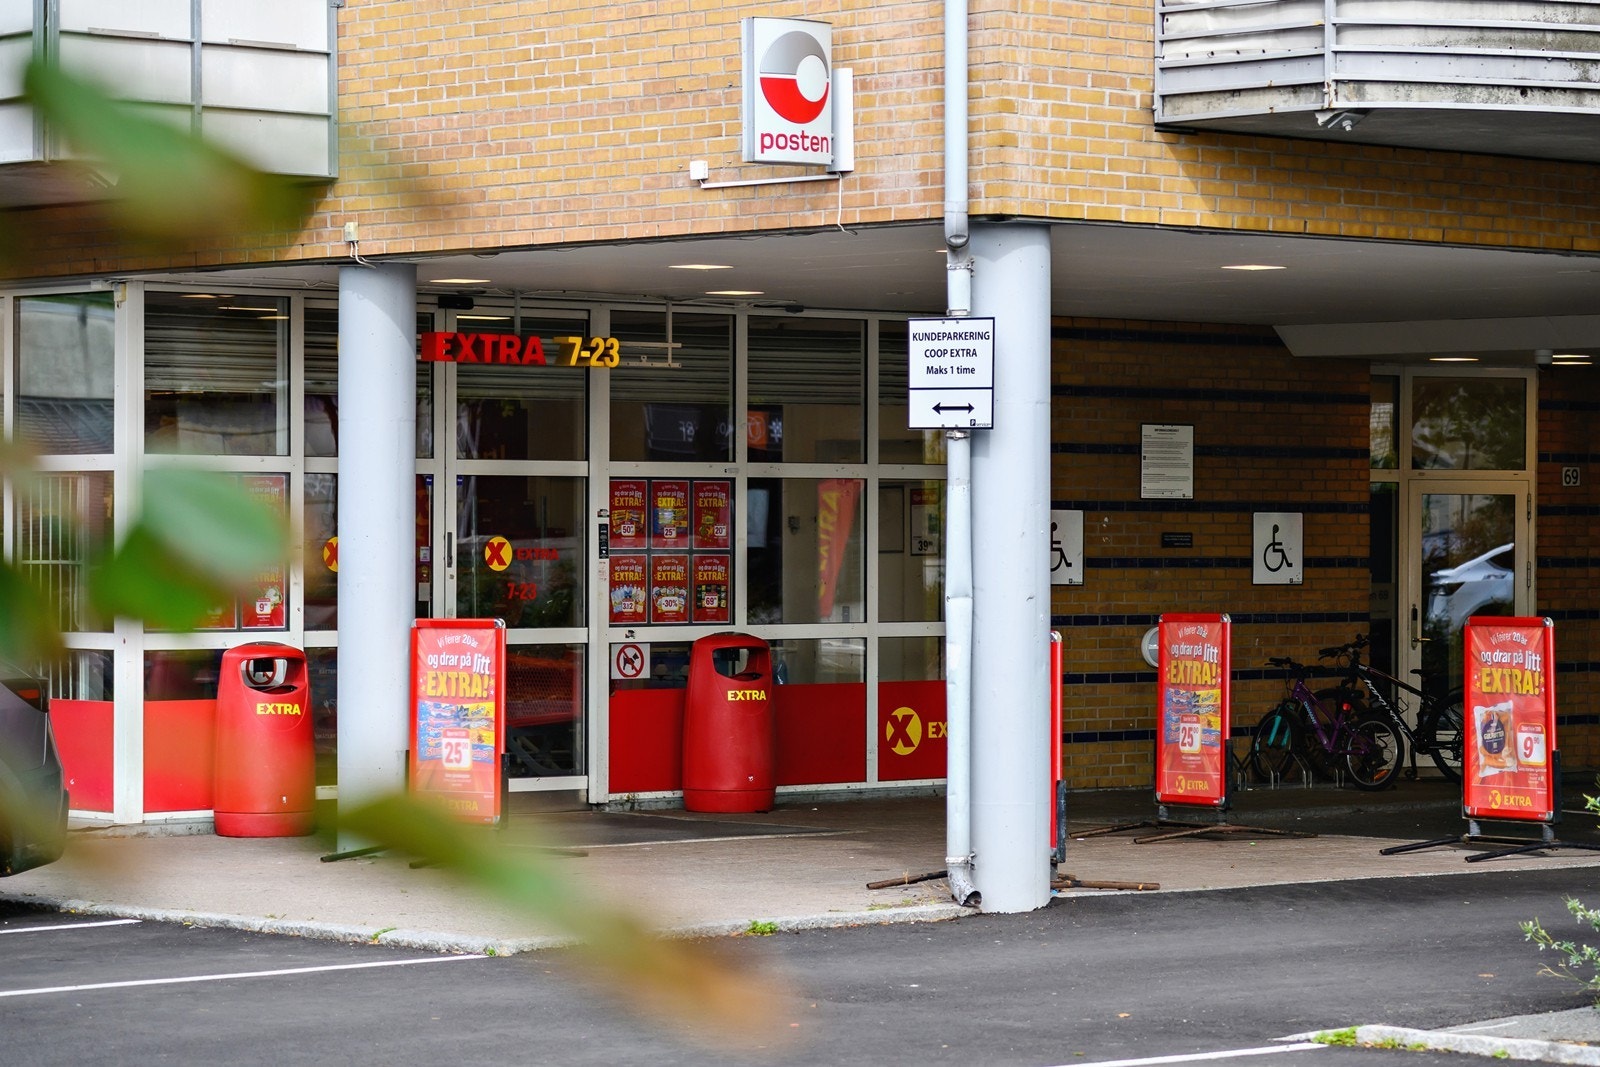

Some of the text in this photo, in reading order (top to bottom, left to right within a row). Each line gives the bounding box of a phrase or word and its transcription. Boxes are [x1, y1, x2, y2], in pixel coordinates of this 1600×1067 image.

[760, 130, 829, 154] posten
[912, 332, 990, 341] KUNDEPARKERING
[435, 332, 620, 368] EXTRA 7-23
[924, 348, 978, 358] COOP EXTRA
[926, 366, 976, 374] Maks 1 time
[1564, 468, 1578, 484] 69
[615, 497, 642, 506] EXTRA!
[658, 498, 684, 506] EXTRA!
[699, 498, 725, 507] EXTRA!
[516, 548, 559, 561] EXTRA
[614, 572, 642, 580] EXTRA!
[657, 572, 684, 580] EXTRA!
[698, 572, 725, 580] EXTRA!
[507, 583, 537, 600] 7-23
[437, 636, 444, 648] Vi
[444, 634, 461, 644] feirer
[1497, 632, 1511, 641] feirer
[1171, 642, 1218, 663] og drar på litt
[428, 652, 490, 674] og drar på litt
[1481, 649, 1541, 672] og drar på litt
[1170, 660, 1216, 685] EXTRA!
[427, 671, 488, 698] EXTRA!
[1482, 668, 1539, 695] EXTRA!
[728, 690, 766, 701] EXTRA
[256, 703, 301, 715] EXTRA
[1187, 780, 1209, 791] EXTRA
[1504, 795, 1532, 806] EXTRA
